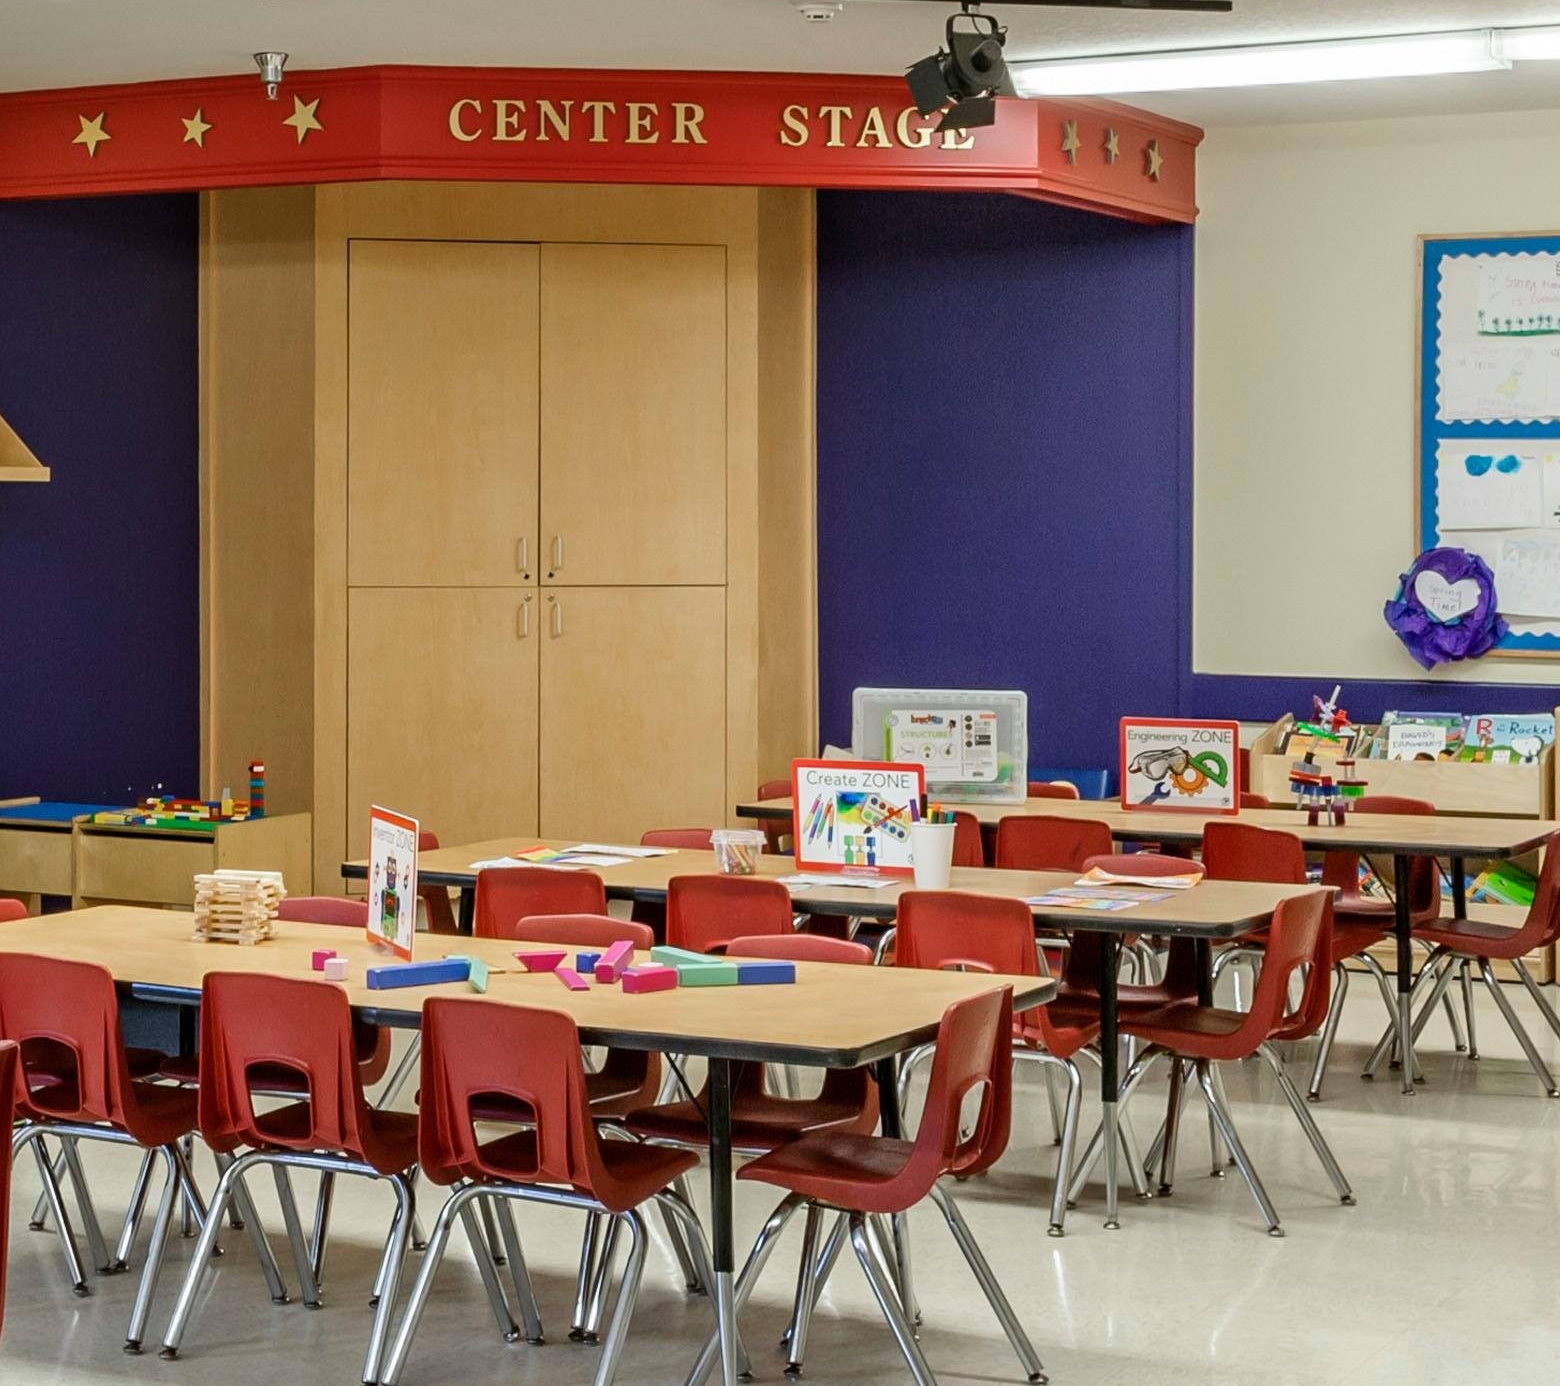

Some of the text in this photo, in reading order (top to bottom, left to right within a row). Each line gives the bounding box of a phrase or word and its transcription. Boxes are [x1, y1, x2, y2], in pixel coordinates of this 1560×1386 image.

[449, 99, 709, 144] CENTER
[1509, 721, 1553, 735] Rocket
[1127, 730, 1232, 744] Engineering ZONE
[806, 770, 911, 789] Create ZONE
